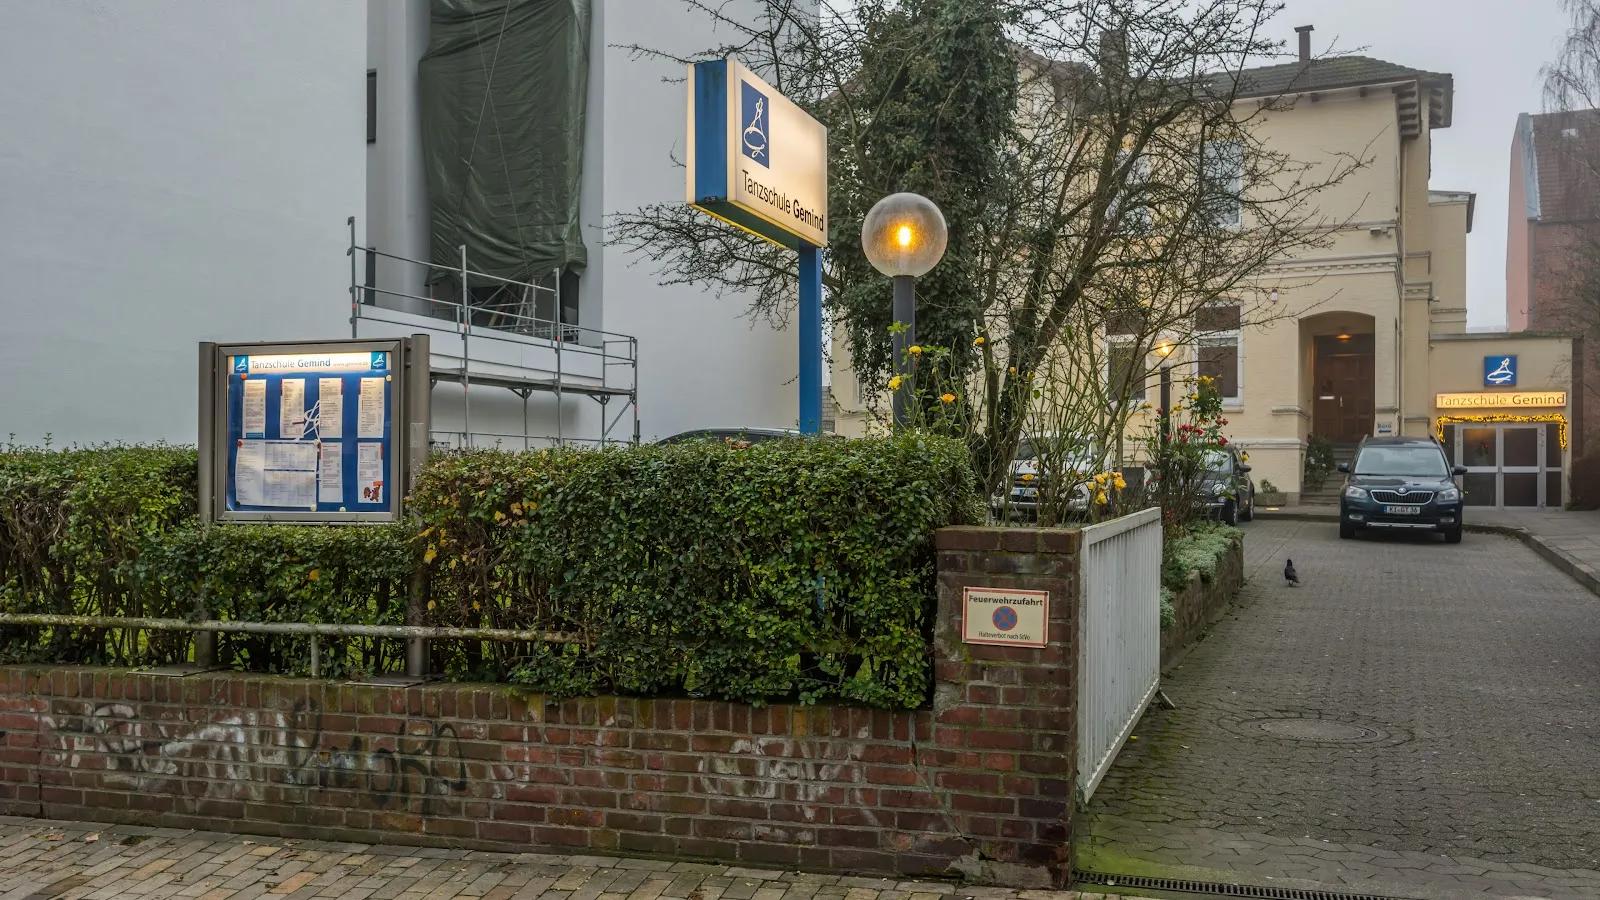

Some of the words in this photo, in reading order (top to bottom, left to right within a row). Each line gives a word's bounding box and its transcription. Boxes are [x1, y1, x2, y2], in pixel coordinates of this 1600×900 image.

[742, 169, 791, 213] Tanzschule
[793, 199, 824, 233] Gemind
[251, 360, 295, 369] Tanzschule
[297, 358, 331, 368] Gemind
[1439, 395, 1507, 406] Tanzschule
[1512, 393, 1565, 405] Gemind
[968, 595, 1043, 606] Feuerwehrzufahrt
[978, 631, 1006, 639] Halteverbot
